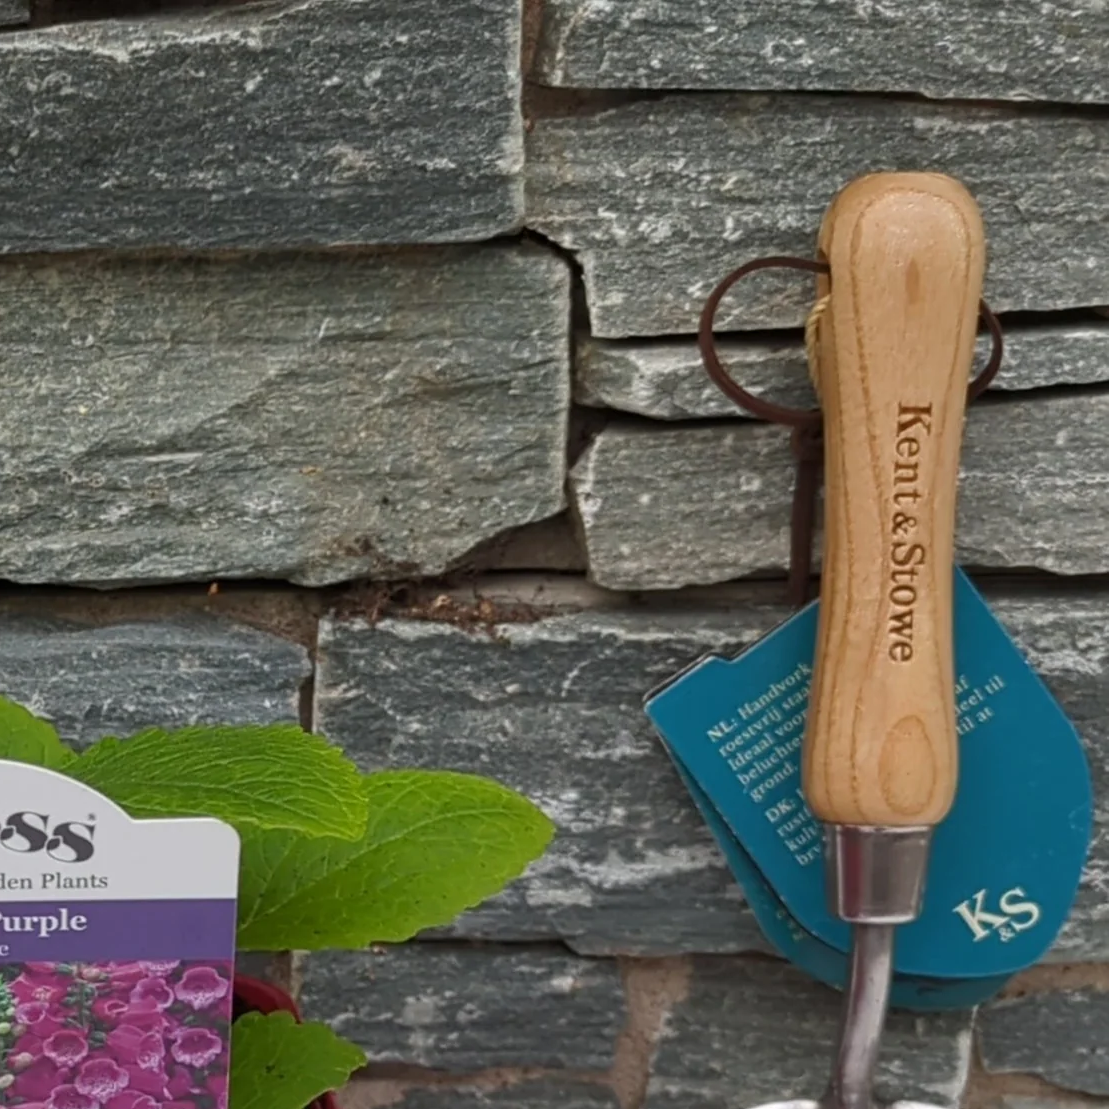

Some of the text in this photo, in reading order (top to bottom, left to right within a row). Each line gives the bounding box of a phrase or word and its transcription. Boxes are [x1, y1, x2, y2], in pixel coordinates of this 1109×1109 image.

[888, 401, 932, 663] Kent & Stowe
[984, 675, 1005, 695] til
[706, 717, 738, 743] NL:
[718, 681, 811, 758] roestvrij staa
[976, 706, 994, 722] at
[727, 708, 809, 772] Ideaal voor
[737, 733, 806, 787] beluchte
[749, 763, 798, 803] grond.
[765, 798, 797, 823] DK:
[41, 873, 109, 890] Plants
[953, 886, 1039, 942] K&S
